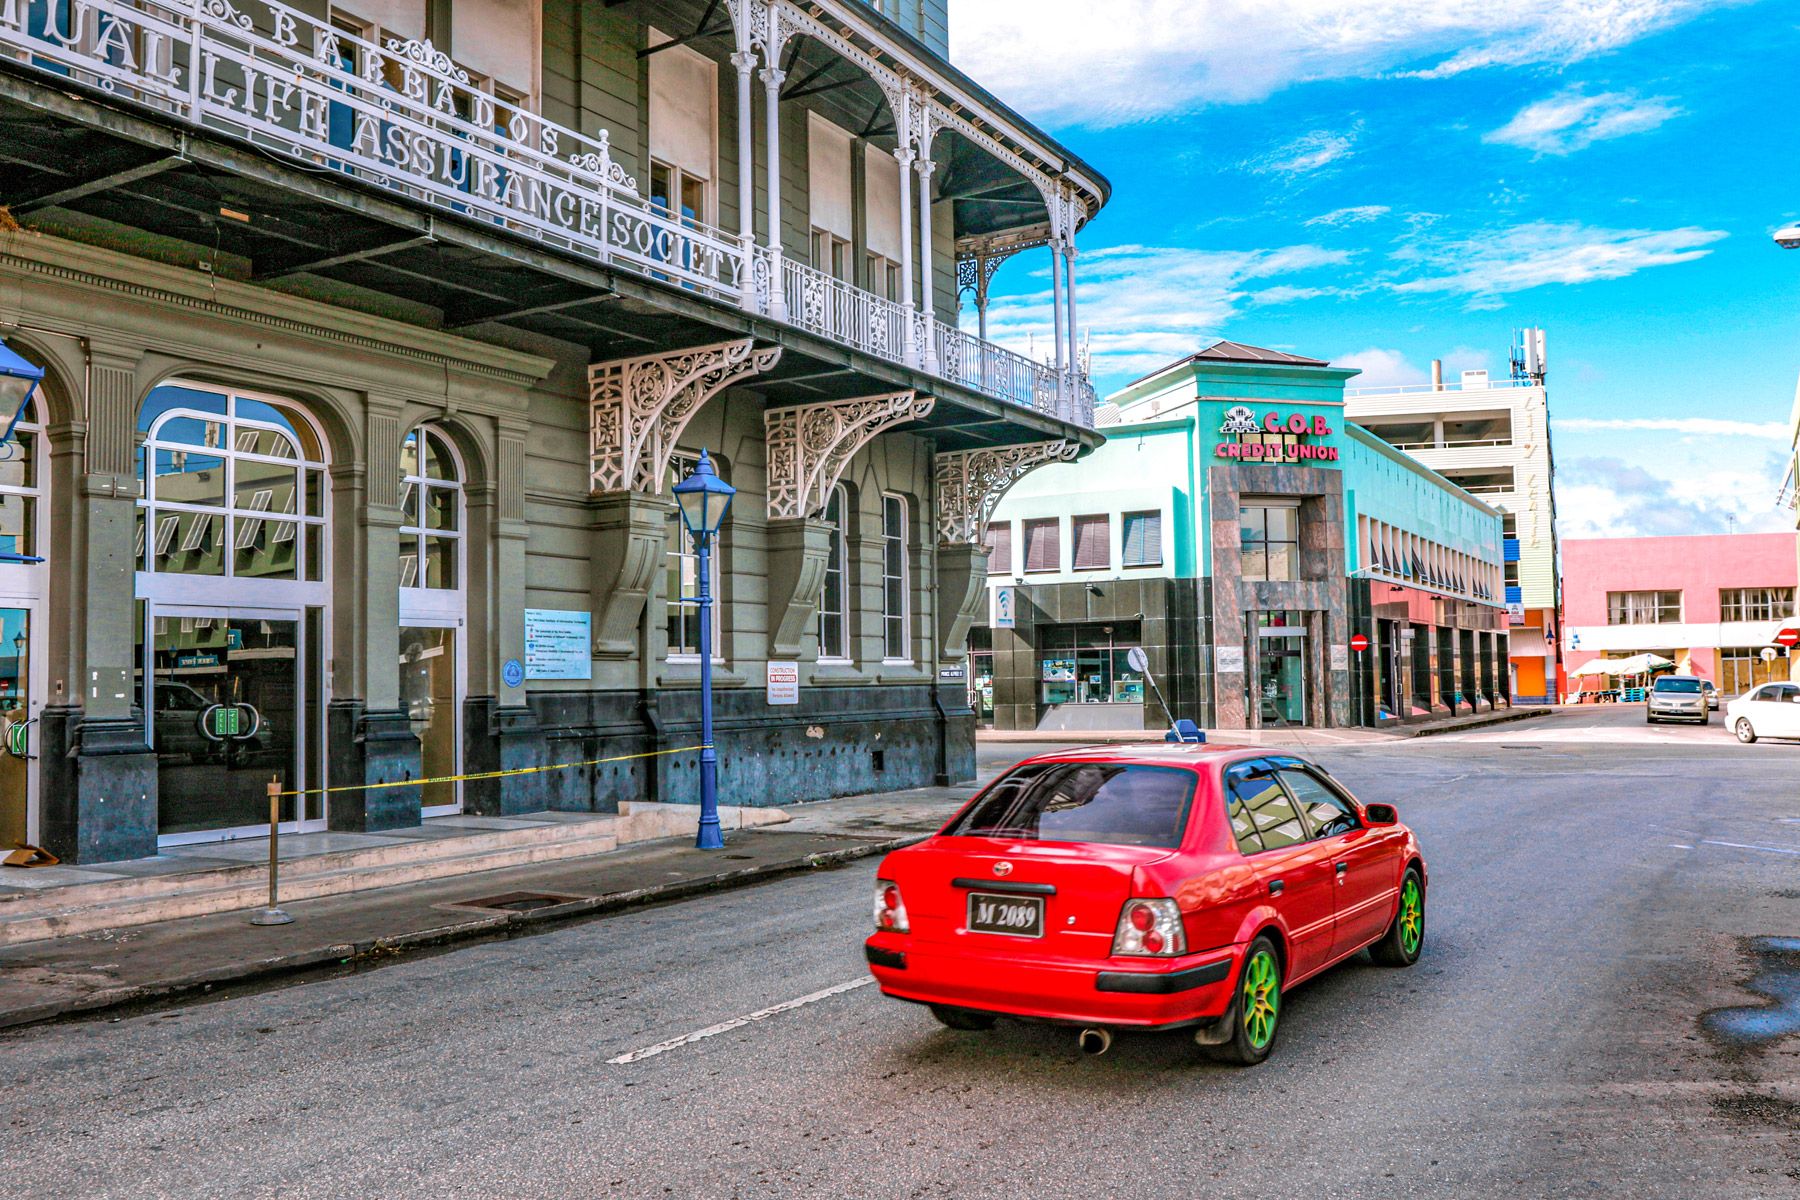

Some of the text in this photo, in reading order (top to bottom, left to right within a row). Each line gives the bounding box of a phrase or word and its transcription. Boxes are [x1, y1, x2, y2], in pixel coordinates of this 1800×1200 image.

[269, 7, 559, 156] BARBADOS
[201, 51, 328, 138] LIFE
[351, 112, 600, 238] ASSURANCE
[611, 212, 745, 289] SOCIETY
[1264, 412, 1332, 436] C.O.B.
[1215, 443, 1339, 460] CREDIT UNION
[975, 902, 1036, 928] M 2089
